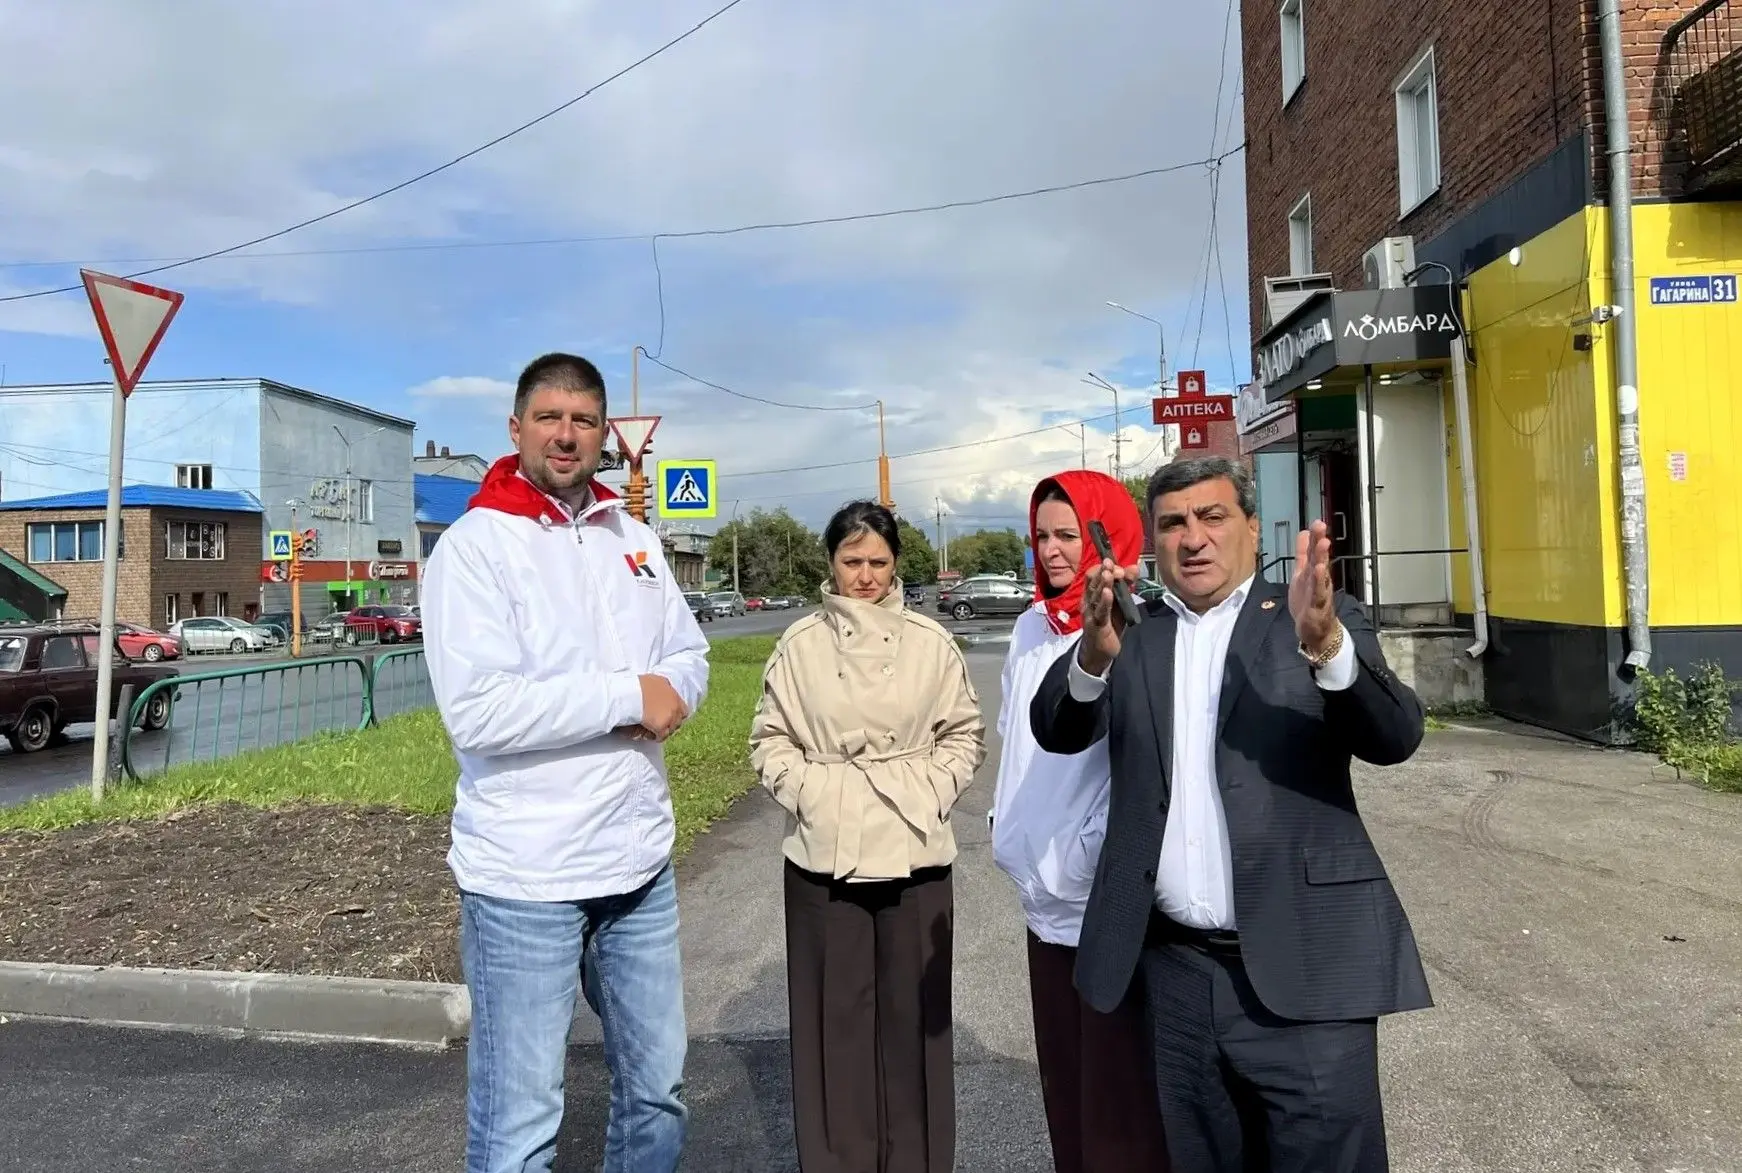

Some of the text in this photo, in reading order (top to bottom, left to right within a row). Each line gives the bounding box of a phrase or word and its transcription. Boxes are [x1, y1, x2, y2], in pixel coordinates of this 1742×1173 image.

[1652, 278, 1735, 302] ГАГАРИНА 31
[1343, 312, 1455, 341] ЛОМБАРД
[1162, 402, 1225, 417] АПТЕКА
